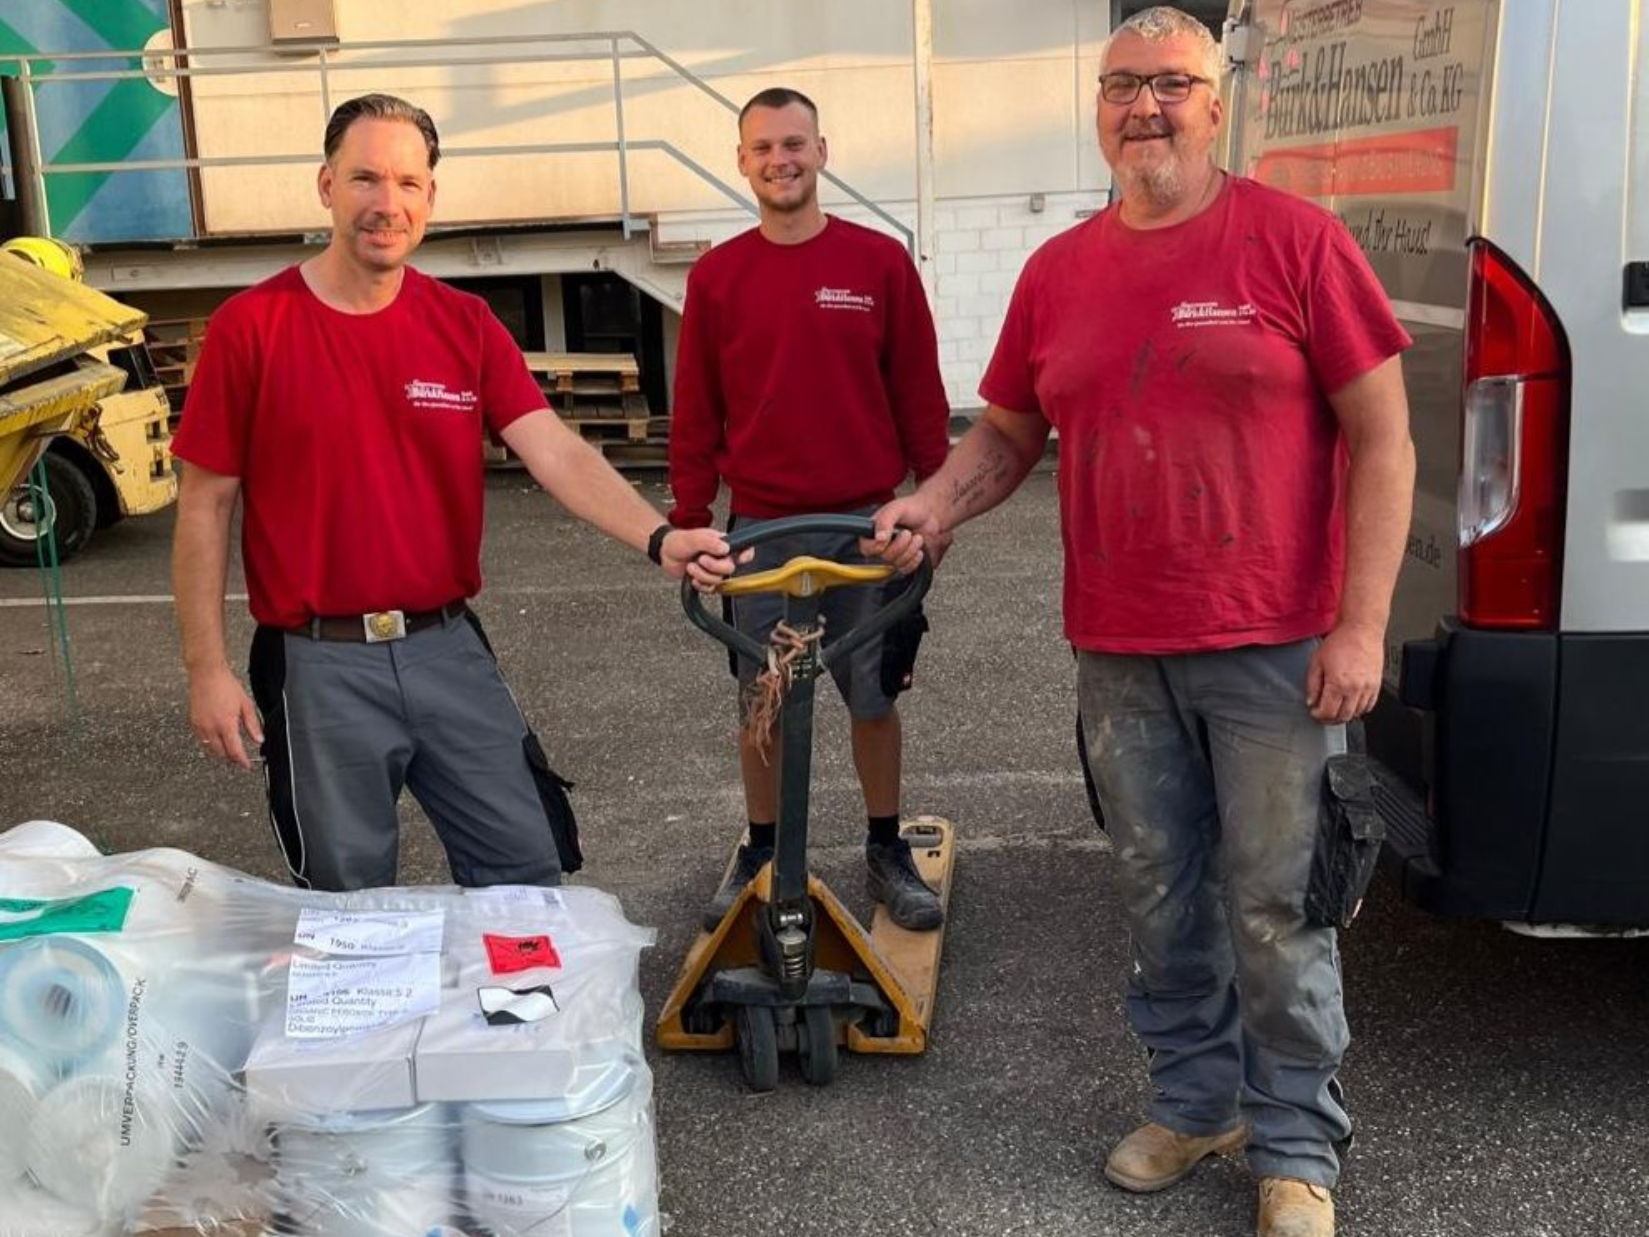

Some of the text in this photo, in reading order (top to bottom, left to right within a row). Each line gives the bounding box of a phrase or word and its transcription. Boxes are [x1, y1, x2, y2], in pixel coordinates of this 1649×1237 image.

[1413, 8, 1455, 60] GmbH
[1440, 63, 1463, 113] KG
[330, 937, 355, 950] 1950
[332, 997, 377, 1009] Quantity
